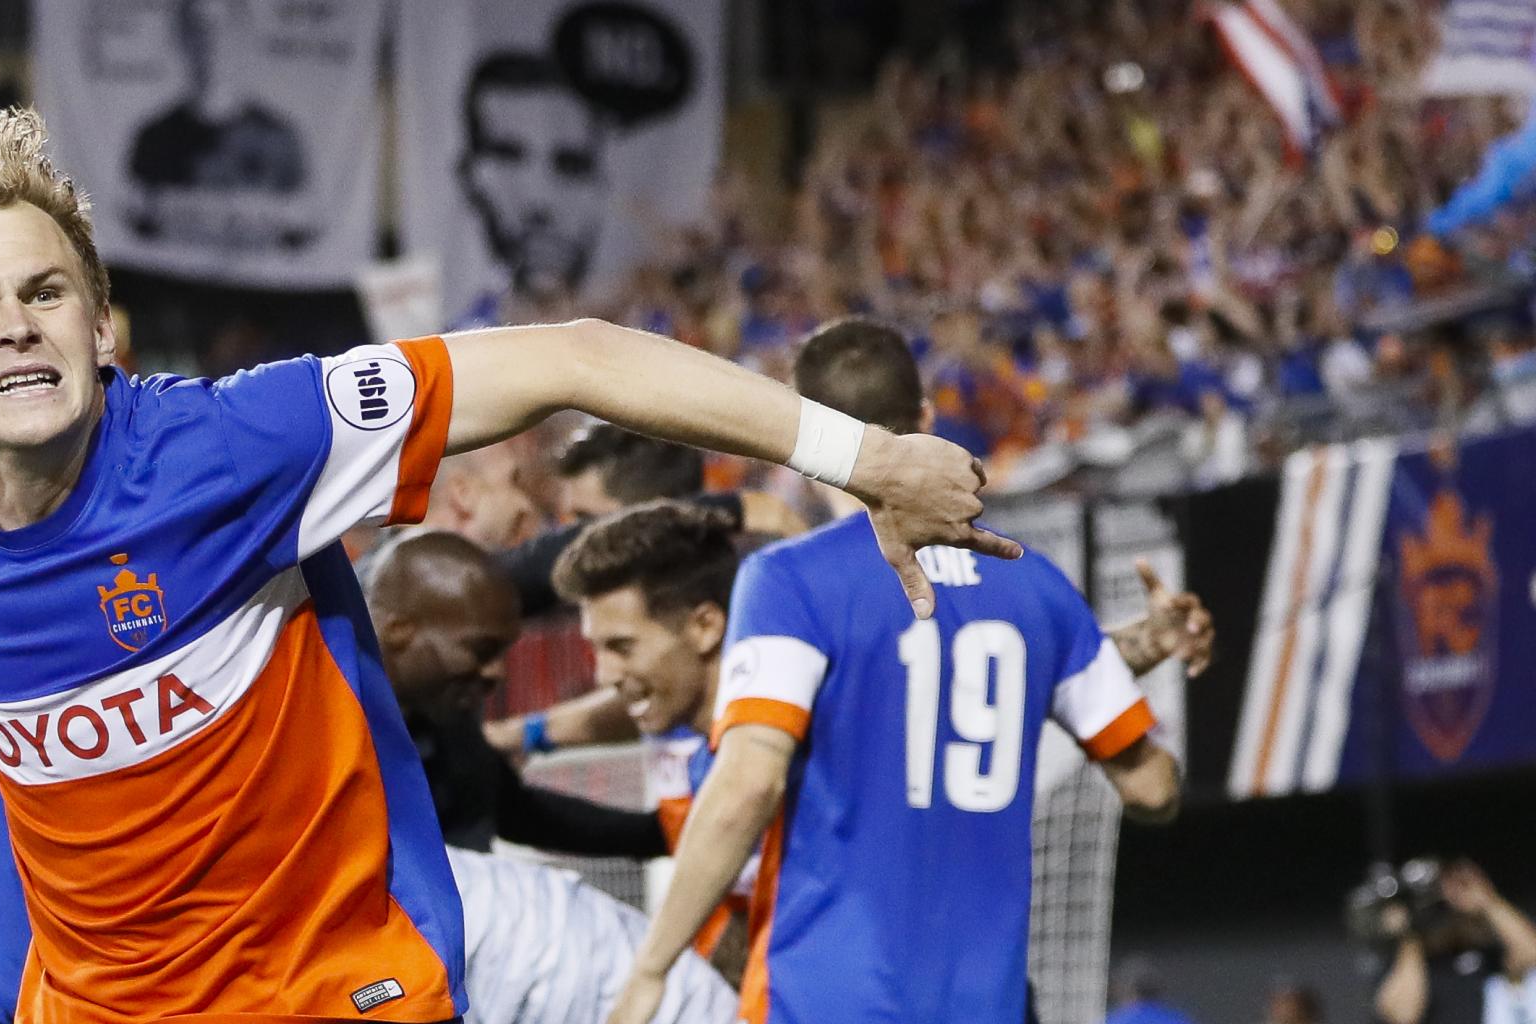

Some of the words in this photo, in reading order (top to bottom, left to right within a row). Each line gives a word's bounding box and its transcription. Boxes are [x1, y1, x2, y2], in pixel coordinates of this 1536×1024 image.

[915, 545, 982, 587] ONE
[112, 593, 152, 621] FC
[112, 614, 163, 633] CINCINNATI
[897, 617, 1027, 813] 19
